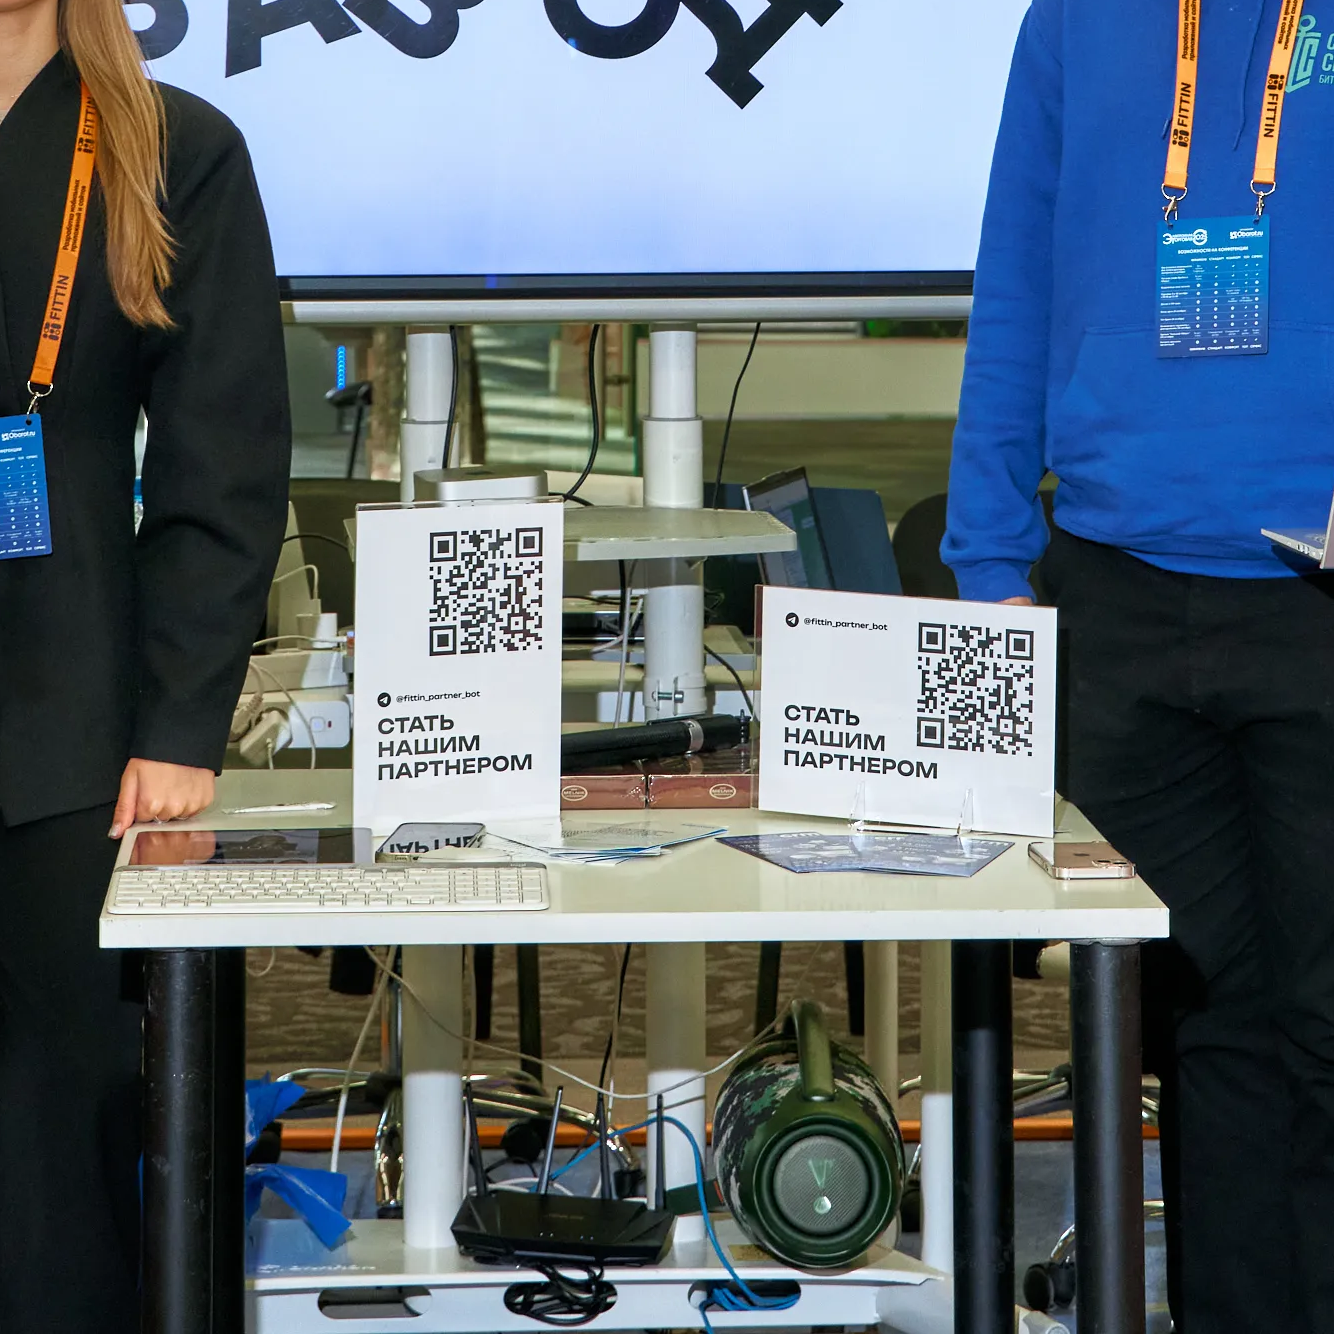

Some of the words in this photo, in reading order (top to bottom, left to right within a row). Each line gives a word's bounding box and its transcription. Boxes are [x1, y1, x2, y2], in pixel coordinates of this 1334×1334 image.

[1177, 82, 1192, 127] FITTIN
[48, 274, 70, 325] FITTIN
[803, 617, 887, 630] @fittin_partner_bot
[396, 690, 480, 702] @fittin_partner_bot
[377, 714, 454, 734] СТАТЬ
[784, 704, 859, 726] СТАТЬ
[378, 734, 479, 757] НАШИМ
[784, 726, 885, 751] НАШИМ
[378, 753, 532, 780] ПАРТНЕРОМ
[783, 749, 937, 779] ПАРТНЕРОМ
